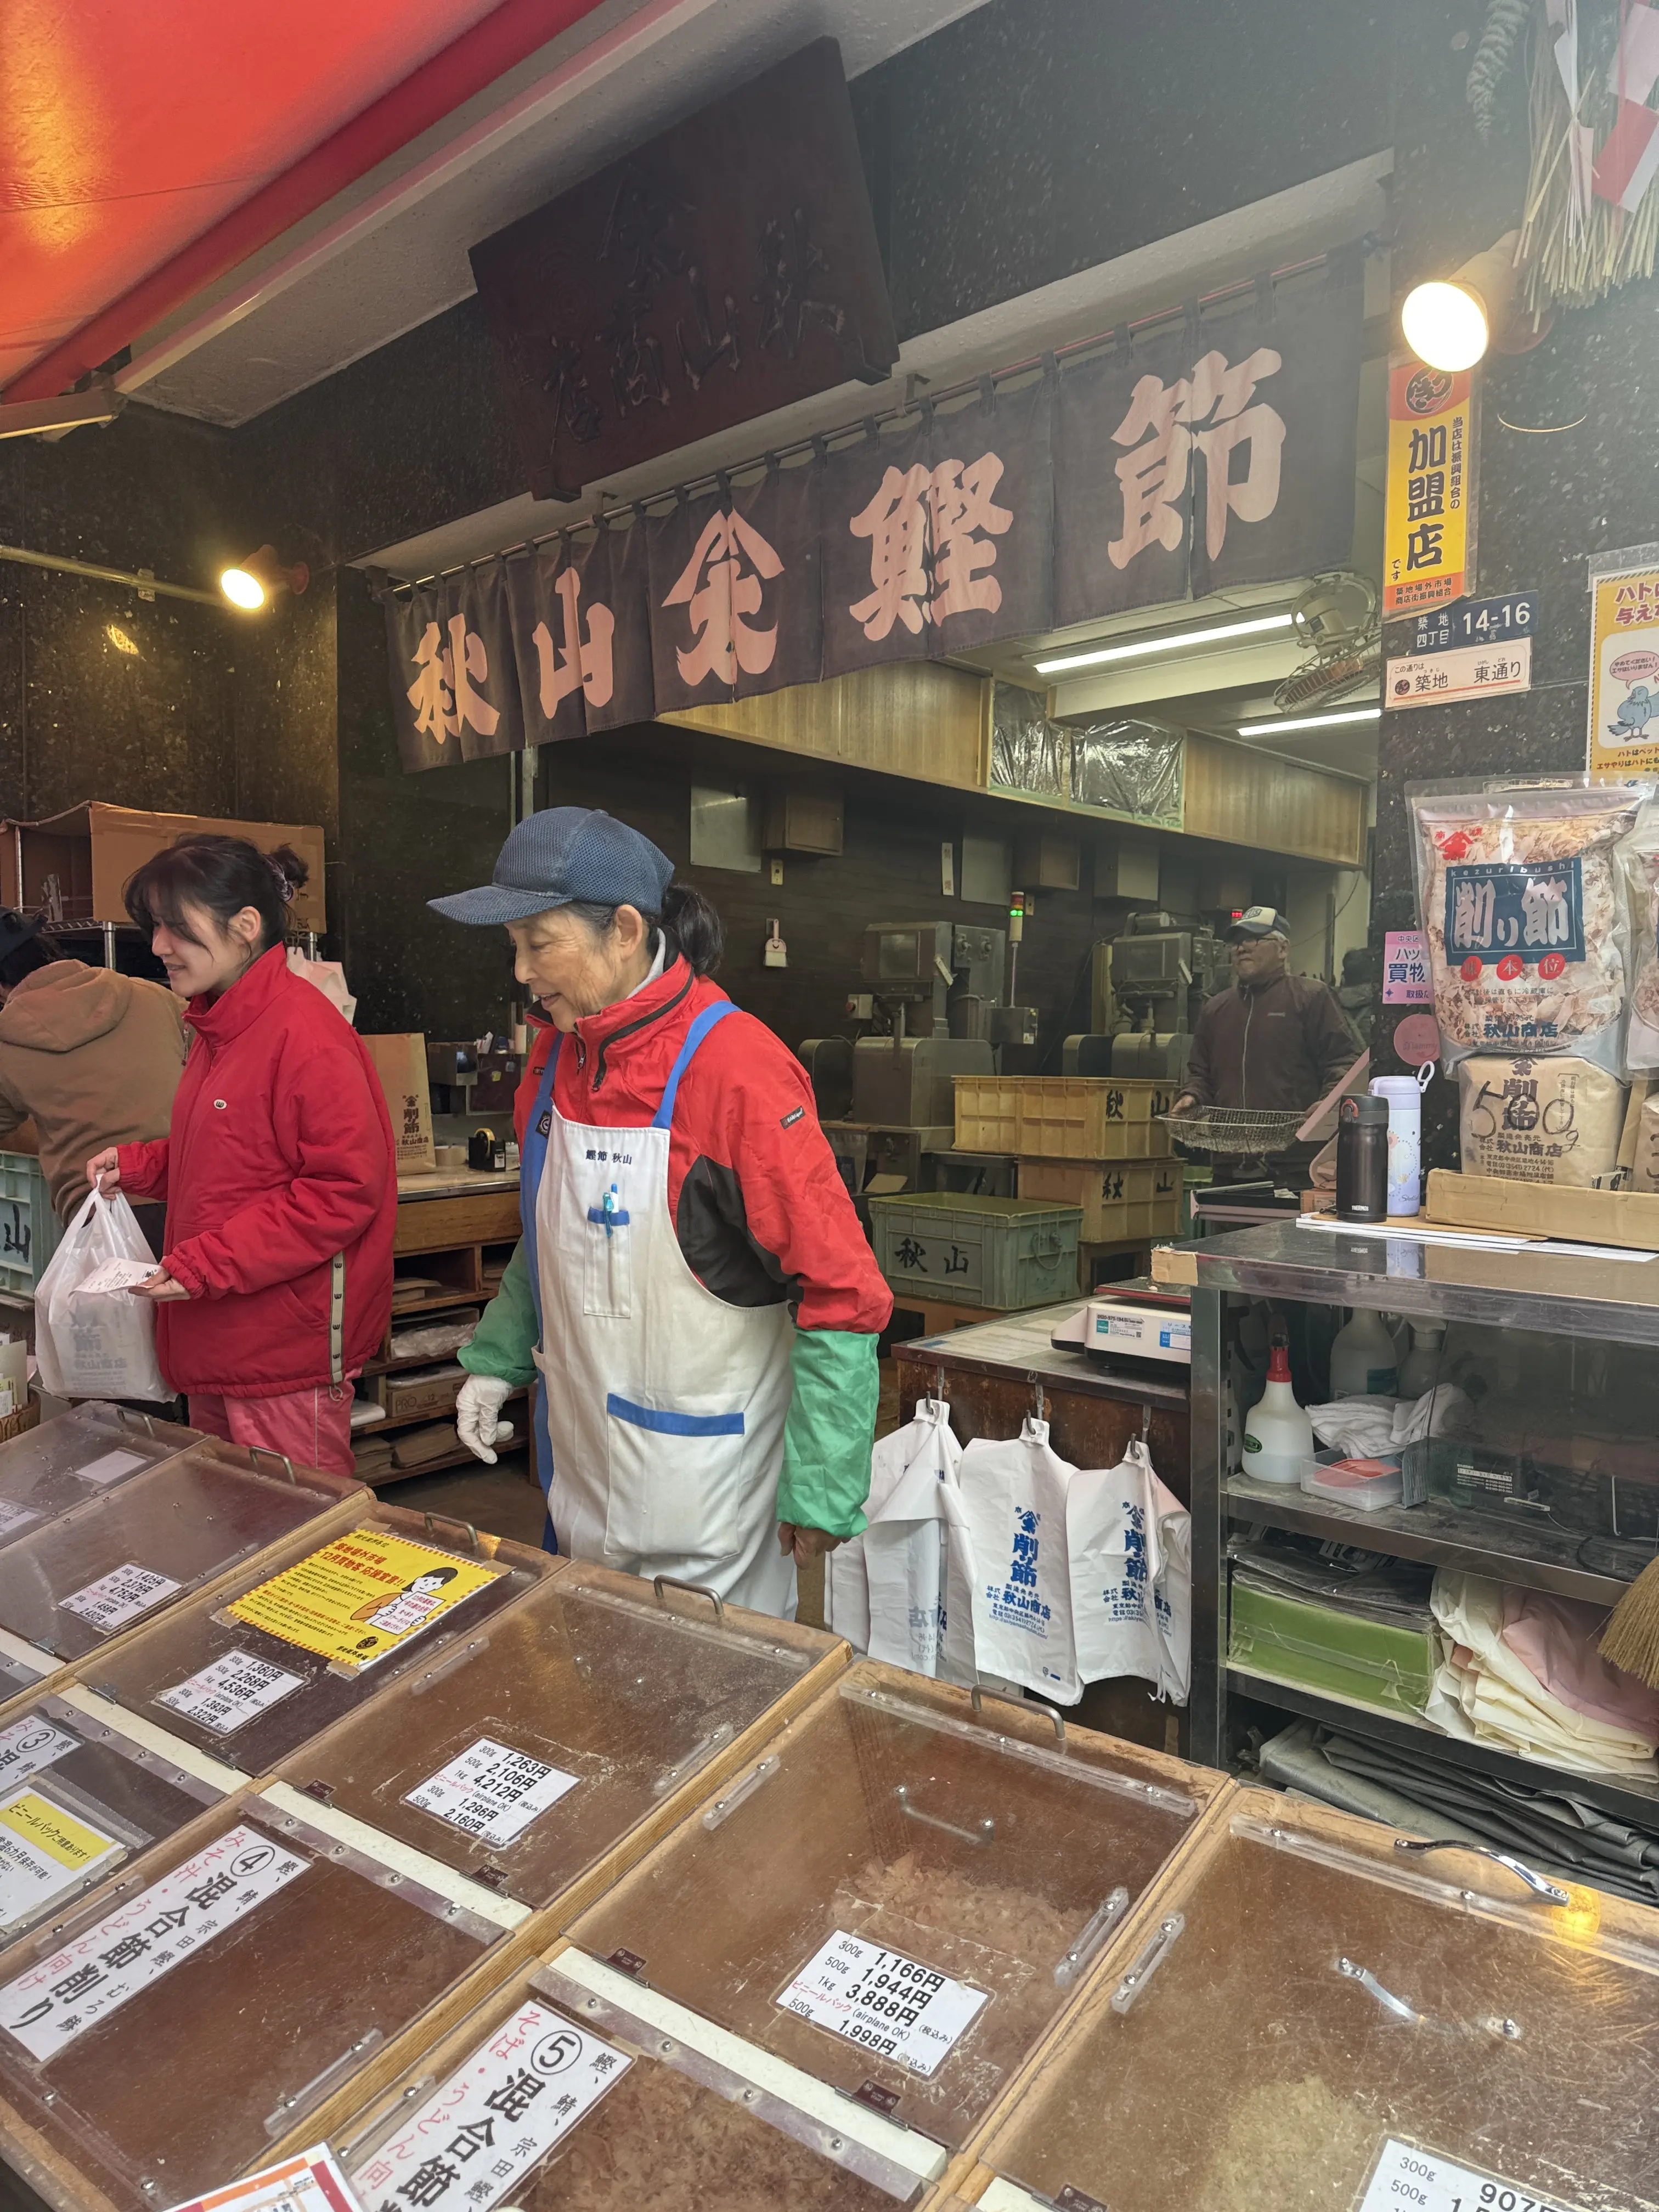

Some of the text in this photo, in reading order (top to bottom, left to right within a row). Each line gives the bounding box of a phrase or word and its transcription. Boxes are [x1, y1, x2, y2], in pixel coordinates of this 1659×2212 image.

[1450, 416, 1464, 510] 当店は振興組合の
[1407, 425, 1447, 571] 加盟店
[1391, 558, 1402, 581] です
[1395, 588, 1452, 605] 商店街振興組合
[1396, 578, 1452, 596] 築地場外市場
[1615, 583, 1659, 602] ハト
[1463, 602, 1530, 634] 14-16
[1615, 604, 1659, 625] 与え
[1417, 629, 1449, 648] 四丁目
[1395, 662, 1424, 674] この通りは
[1415, 661, 1521, 692] 築地 東通り
[1454, 876, 1569, 948] 削り節
[1483, 1022, 1559, 1038] 秋山商店
[586, 1149, 632, 1165] 鰹節 秋山
[1496, 1140, 1562, 1158] 秋山商店
[1102, 1171, 1174, 1200] 秋山
[4, 1204, 30, 1263] 山
[895, 1237, 969, 1273] 秋山
[332, 1543, 387, 1565] 築地場外市場
[1011, 1533, 1039, 1587] 削り節
[109, 1585, 140, 1602] 4,752円
[1002, 1590, 1051, 1621] 秋山商店
[230, 1669, 270, 1691] 2,268円
[246, 1661, 284, 1681] 1,360円
[218, 1679, 256, 1700] 4,536円
[187, 1706, 219, 1724] 2,322円
[201, 1697, 232, 1716] 1,393円
[465, 1757, 538, 1791] 500g 2,106円
[479, 1746, 552, 1779] 300g 1,263円
[433, 1773, 474, 1793] ビニールパック
[454, 1769, 468, 1780] 1kg
[473, 1775, 523, 1803] 4,212円
[413, 1795, 432, 1808] 500g
[443, 1809, 486, 1832] 2,160円
[427, 1785, 499, 1821] 300g 1,296円
[16, 1831, 246, 1990] みそ汁・うどん向け
[838, 1940, 946, 1993] 300g 1,166円
[825, 1956, 933, 2010] 500g 1,944円
[792, 1979, 911, 2042] ビニールパック (airplane OK)
[817, 1976, 953, 2044] 1kg 3,888円 (税込み)
[788, 1998, 815, 2018] 500g
[839, 2019, 898, 2055] 1,998円
[1399, 2156, 1438, 2182] 300g
[1390, 2179, 1429, 2206] 500g
